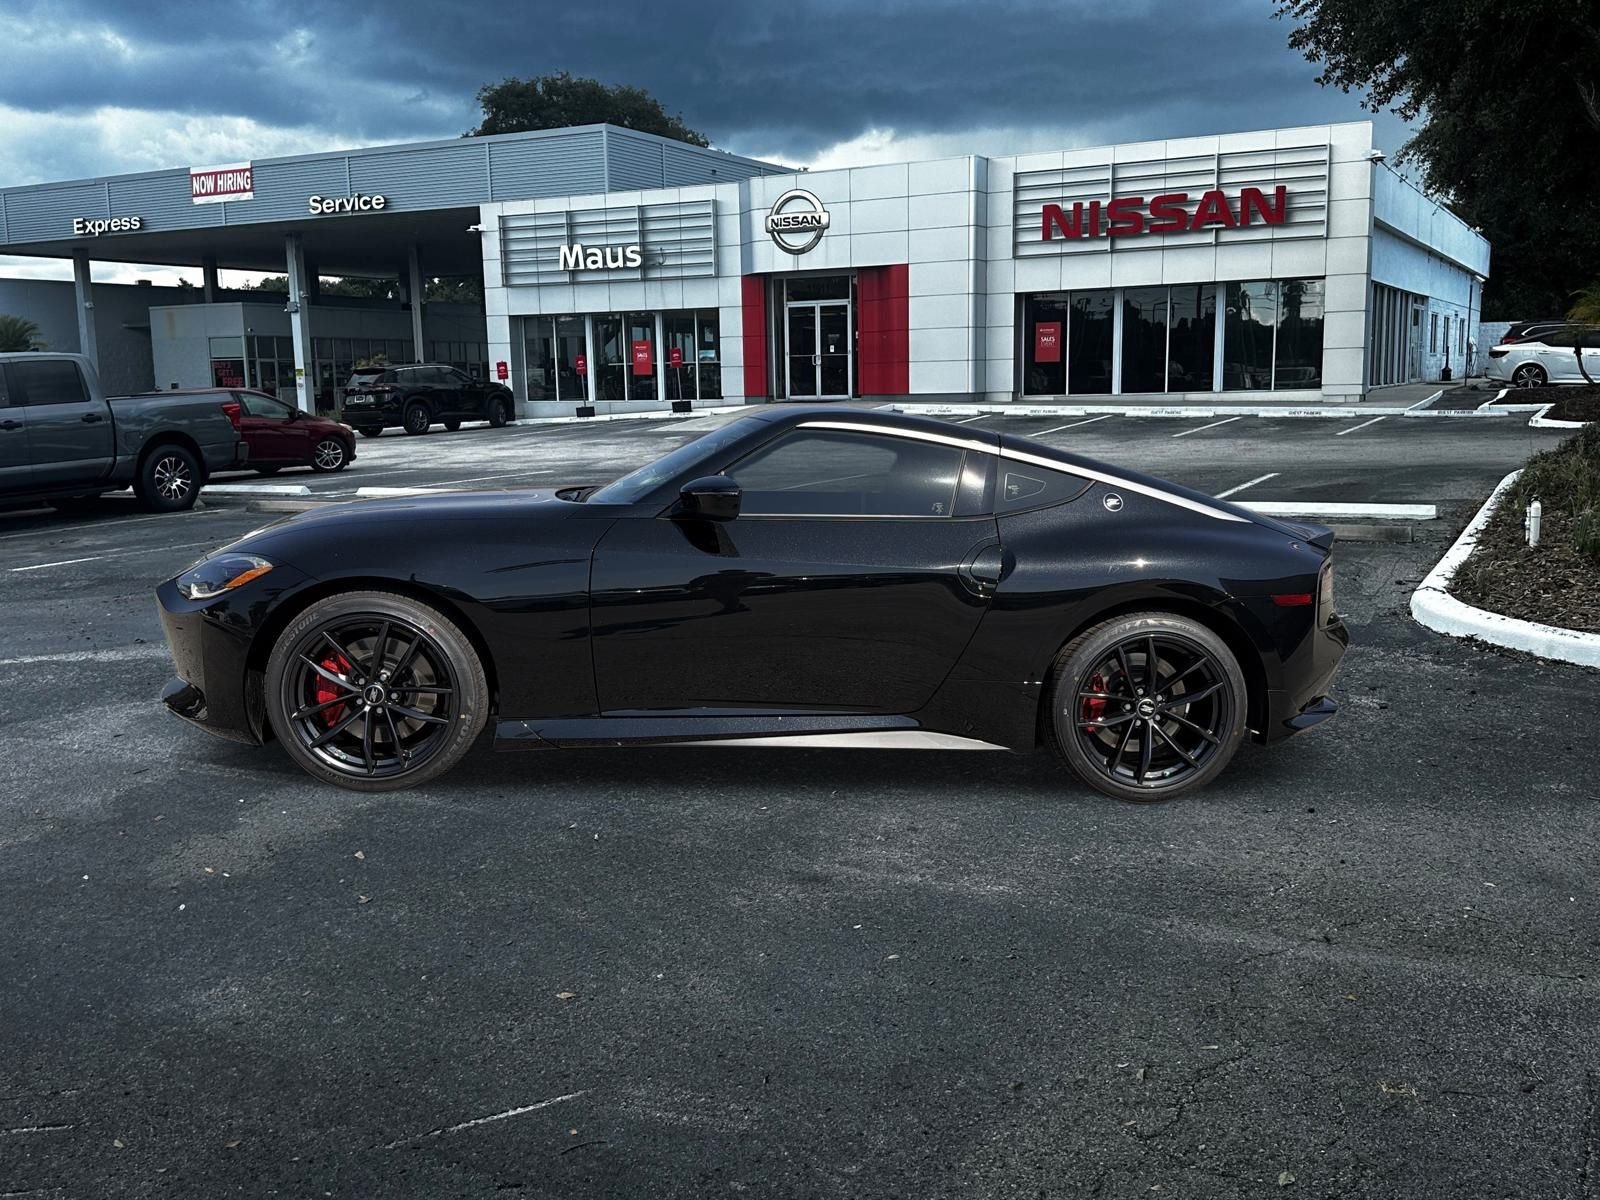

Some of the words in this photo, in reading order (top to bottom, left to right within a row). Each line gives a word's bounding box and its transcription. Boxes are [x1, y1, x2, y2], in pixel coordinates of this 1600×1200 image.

[192, 176, 215, 196] NOW
[217, 171, 251, 193] HIRING
[309, 194, 385, 214] Service
[1041, 185, 1287, 241] NISSAN
[73, 215, 141, 236] Express
[770, 214, 822, 228] NISSAN
[559, 244, 642, 271] Maus
